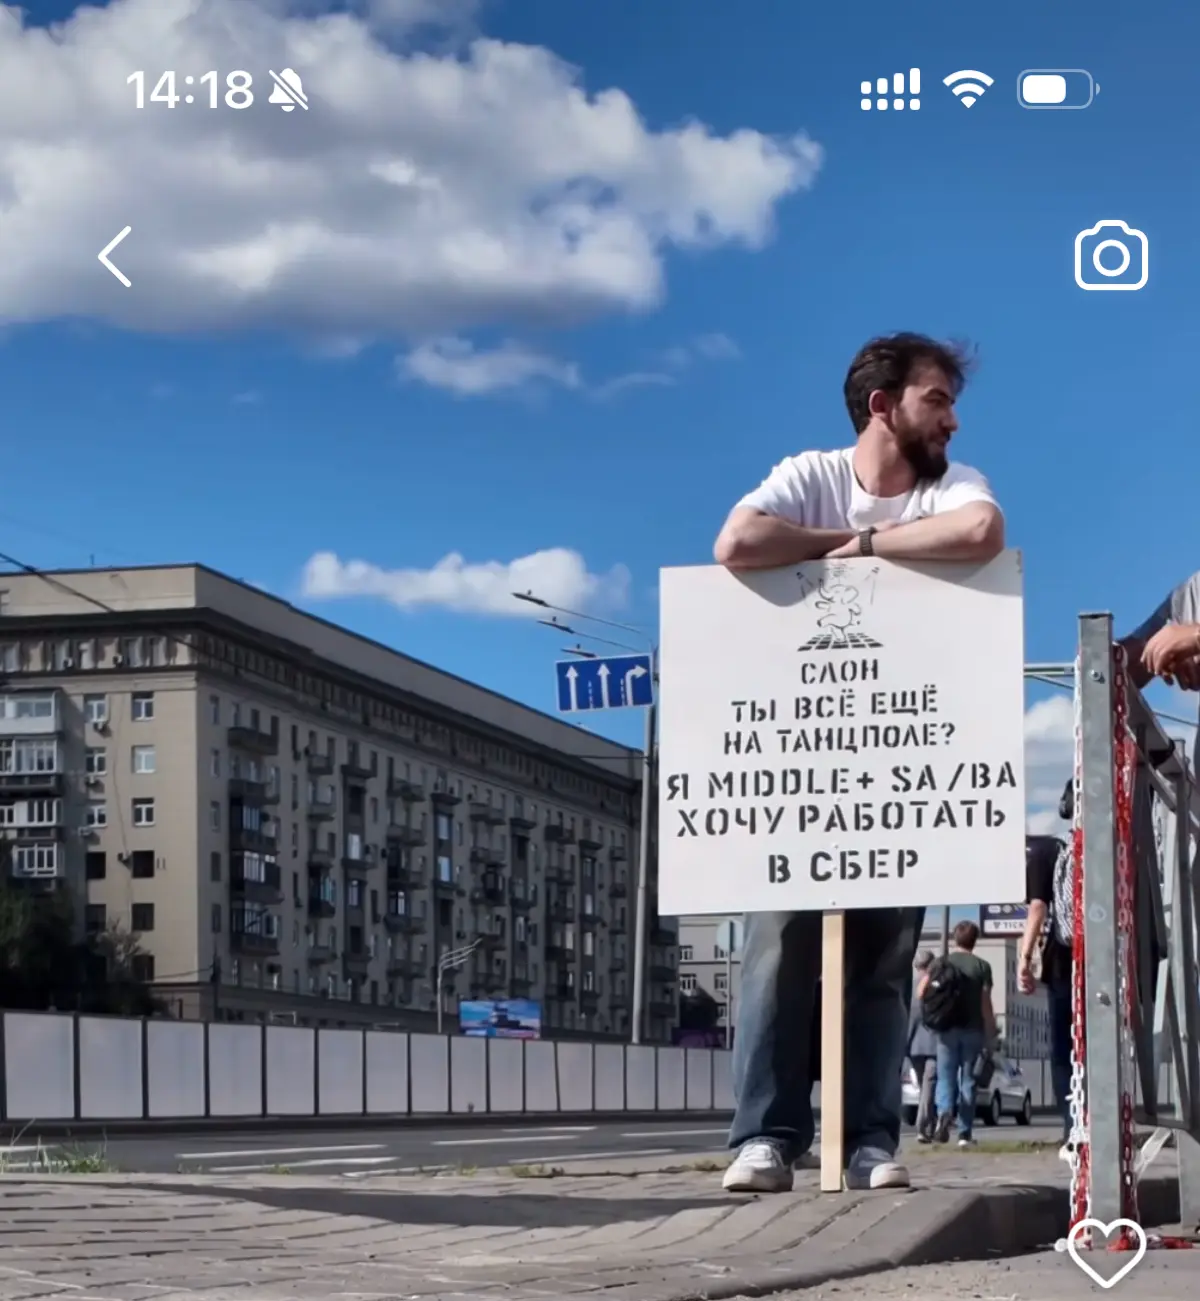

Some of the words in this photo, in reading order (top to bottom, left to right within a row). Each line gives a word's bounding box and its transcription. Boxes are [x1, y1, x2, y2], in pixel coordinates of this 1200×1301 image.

[800, 658, 879, 685] СЛОН
[730, 699, 776, 723] ТЫ
[793, 688, 855, 720] ВСЁ
[870, 684, 938, 717] ЕЩЁ
[723, 730, 762, 755] НА
[775, 722, 956, 754] ТАНЦПОЛЕ?
[666, 773, 689, 801] Я
[707, 767, 875, 799] MIDDLE+
[676, 806, 785, 838] ХОЧУ
[797, 799, 1006, 833] РАБОТАТЬ
[767, 854, 791, 884] В
[809, 848, 919, 882] СБЕР
